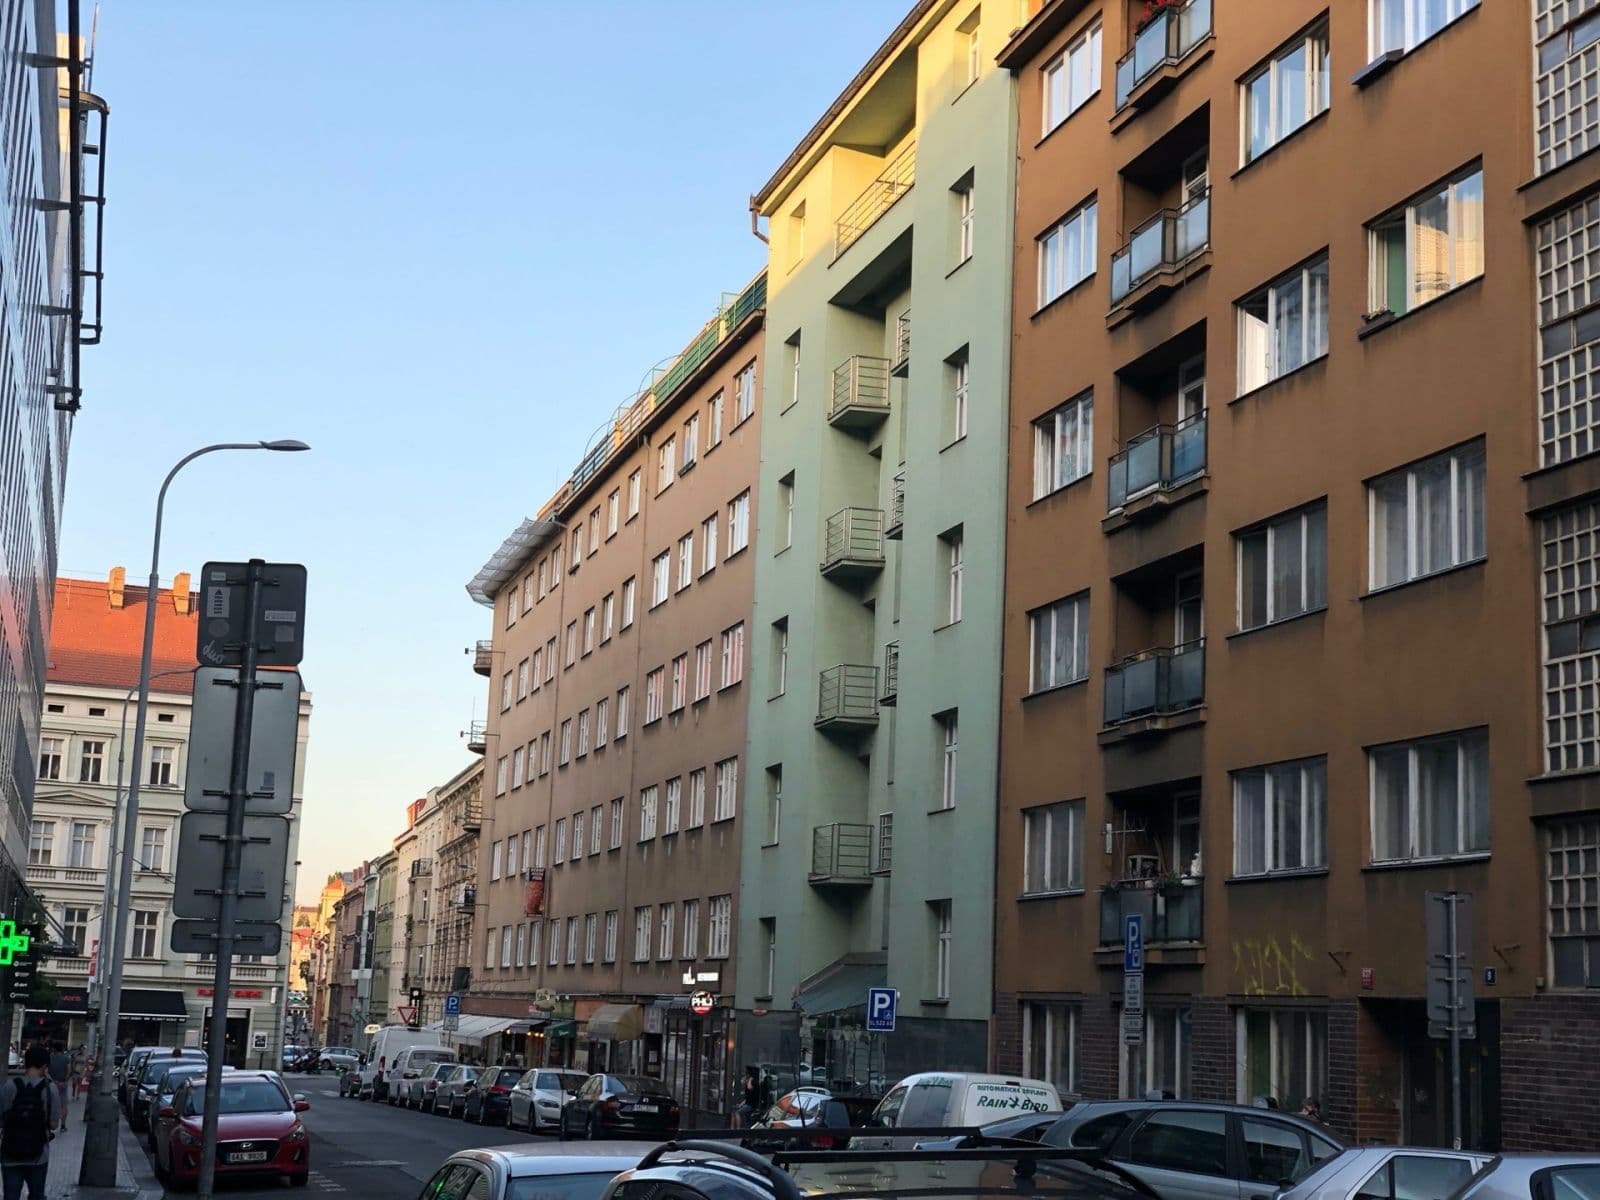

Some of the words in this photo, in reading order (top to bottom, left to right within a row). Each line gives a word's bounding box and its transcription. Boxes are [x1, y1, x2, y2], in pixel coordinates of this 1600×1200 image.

[1128, 921, 1139, 954] P
[447, 996, 458, 1009] P
[873, 992, 891, 1018] P
[976, 1096, 1009, 1109] RAIN
[1021, 1099, 1049, 1112] BIRD
